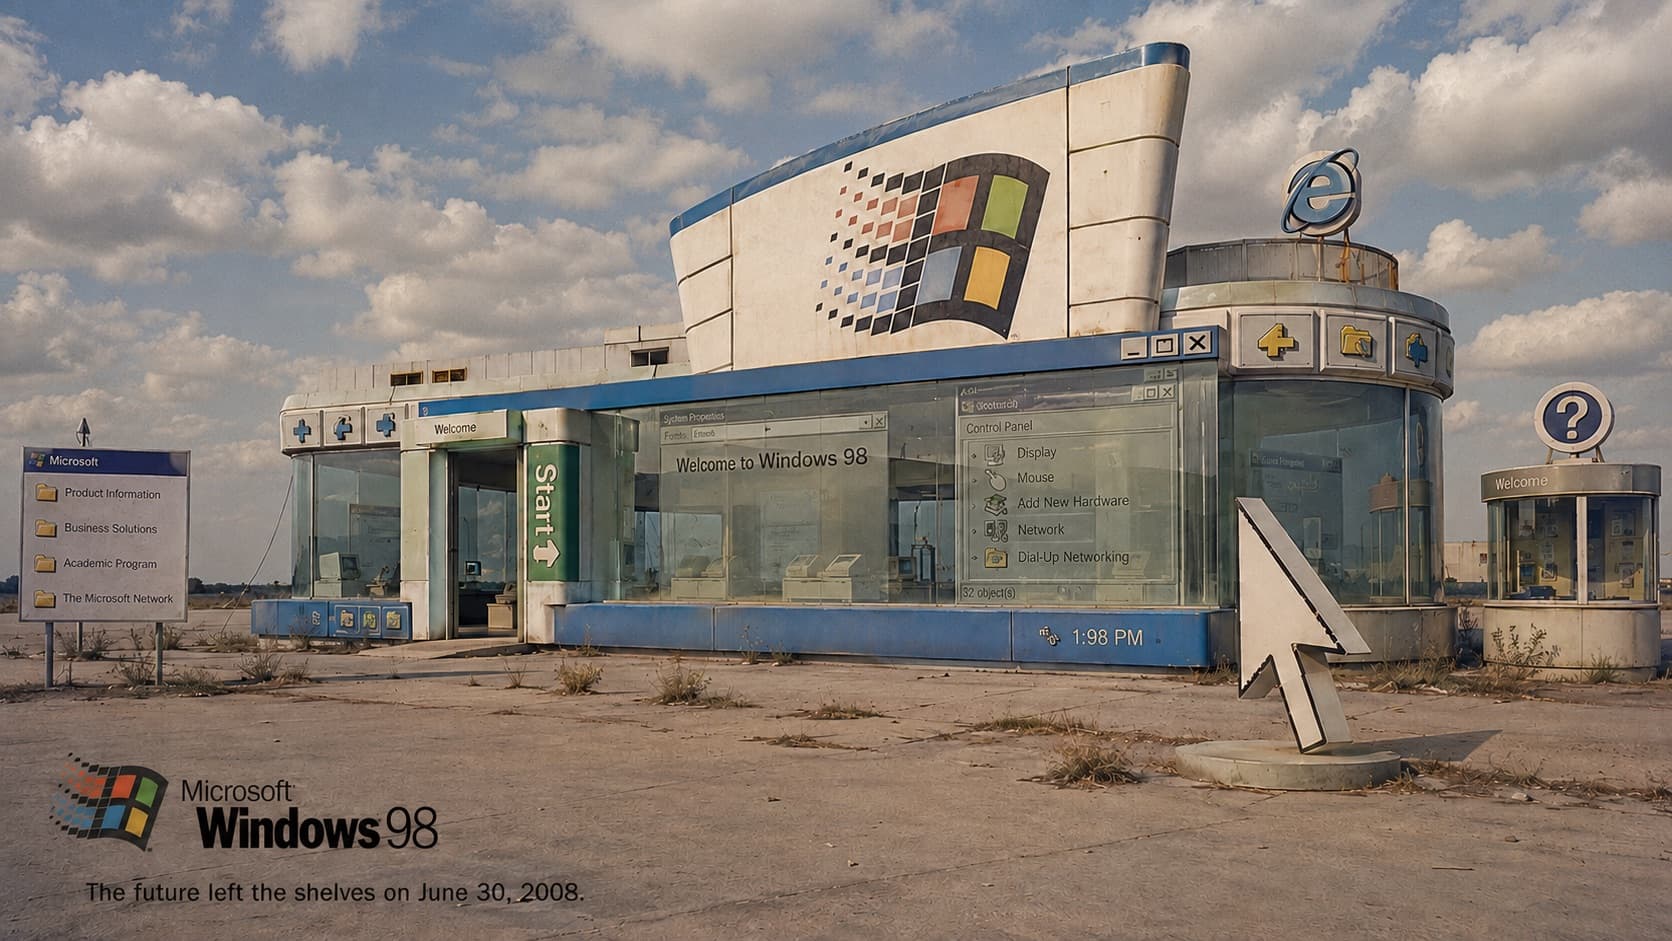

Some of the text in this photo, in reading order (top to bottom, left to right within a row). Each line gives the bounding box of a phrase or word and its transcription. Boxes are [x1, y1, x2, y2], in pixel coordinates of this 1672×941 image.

[434, 421, 477, 435] Welcome
[966, 420, 1033, 434] Control Panel
[677, 447, 868, 473] Welcome to Windows 98
[1017, 446, 1057, 461] Display
[49, 454, 99, 468] Microsoft
[1017, 471, 1054, 484] Mouse
[1496, 475, 1549, 491] Welcome
[65, 487, 161, 500] Product Information
[534, 462, 559, 537] Start
[1017, 495, 1129, 509] Add New Hardware
[64, 523, 158, 535] Business Solutions
[1018, 523, 1065, 536] Network
[63, 557, 157, 572] Academic Program
[1018, 551, 1130, 566] Dial-Up Networking
[63, 592, 174, 604] The Microsoft Network
[962, 586, 1016, 600] 32 object(s)
[1072, 628, 1143, 646] 1:98 PM
